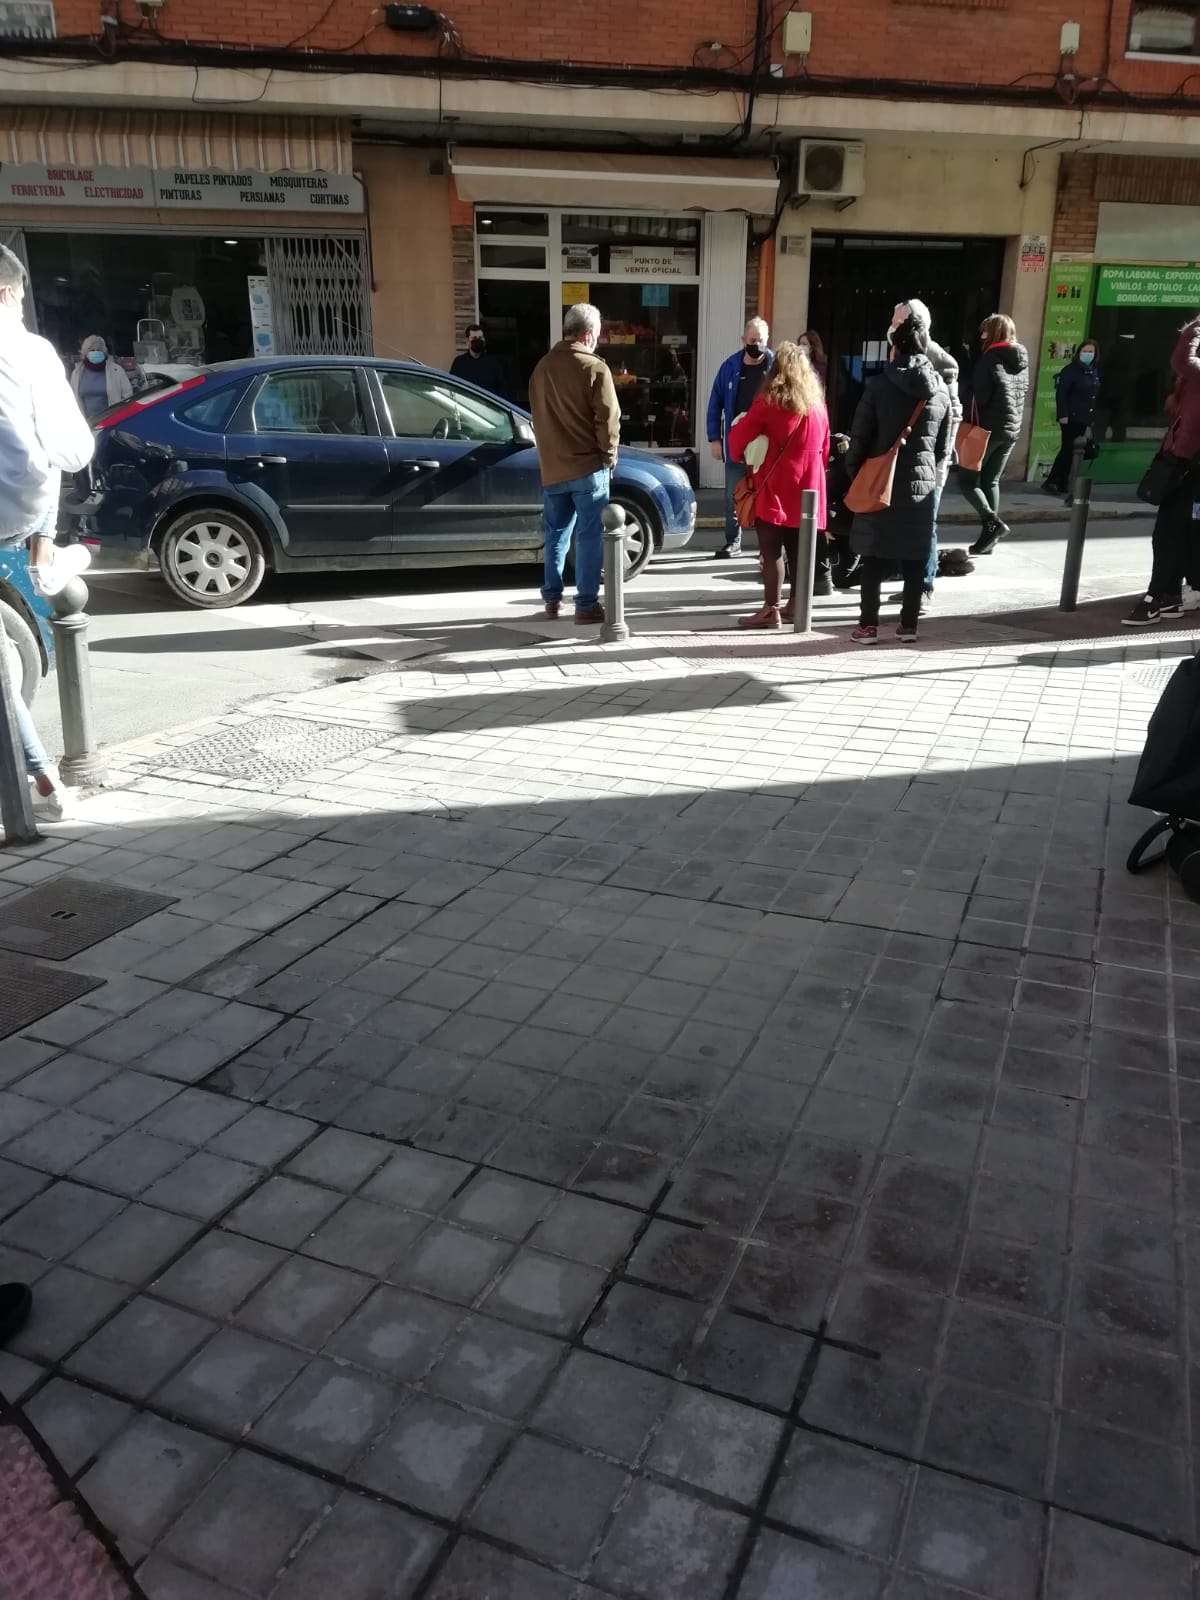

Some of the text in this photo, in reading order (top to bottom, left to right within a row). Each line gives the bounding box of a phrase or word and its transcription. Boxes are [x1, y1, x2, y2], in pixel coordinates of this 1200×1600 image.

[47, 169, 94, 181] BRICOLAGE
[174, 173, 253, 187] PAPELES PINTADOS
[270, 176, 328, 189] MOSQUITERAS
[84, 186, 144, 200] ELECTRICIDAD
[160, 188, 350, 206] PINTURAS PERSIANAS CORTINAS
[1103, 269, 1124, 279] ROPA
[1125, 270, 1160, 280] LABORAL
[1111, 282, 1142, 291] VINILOS
